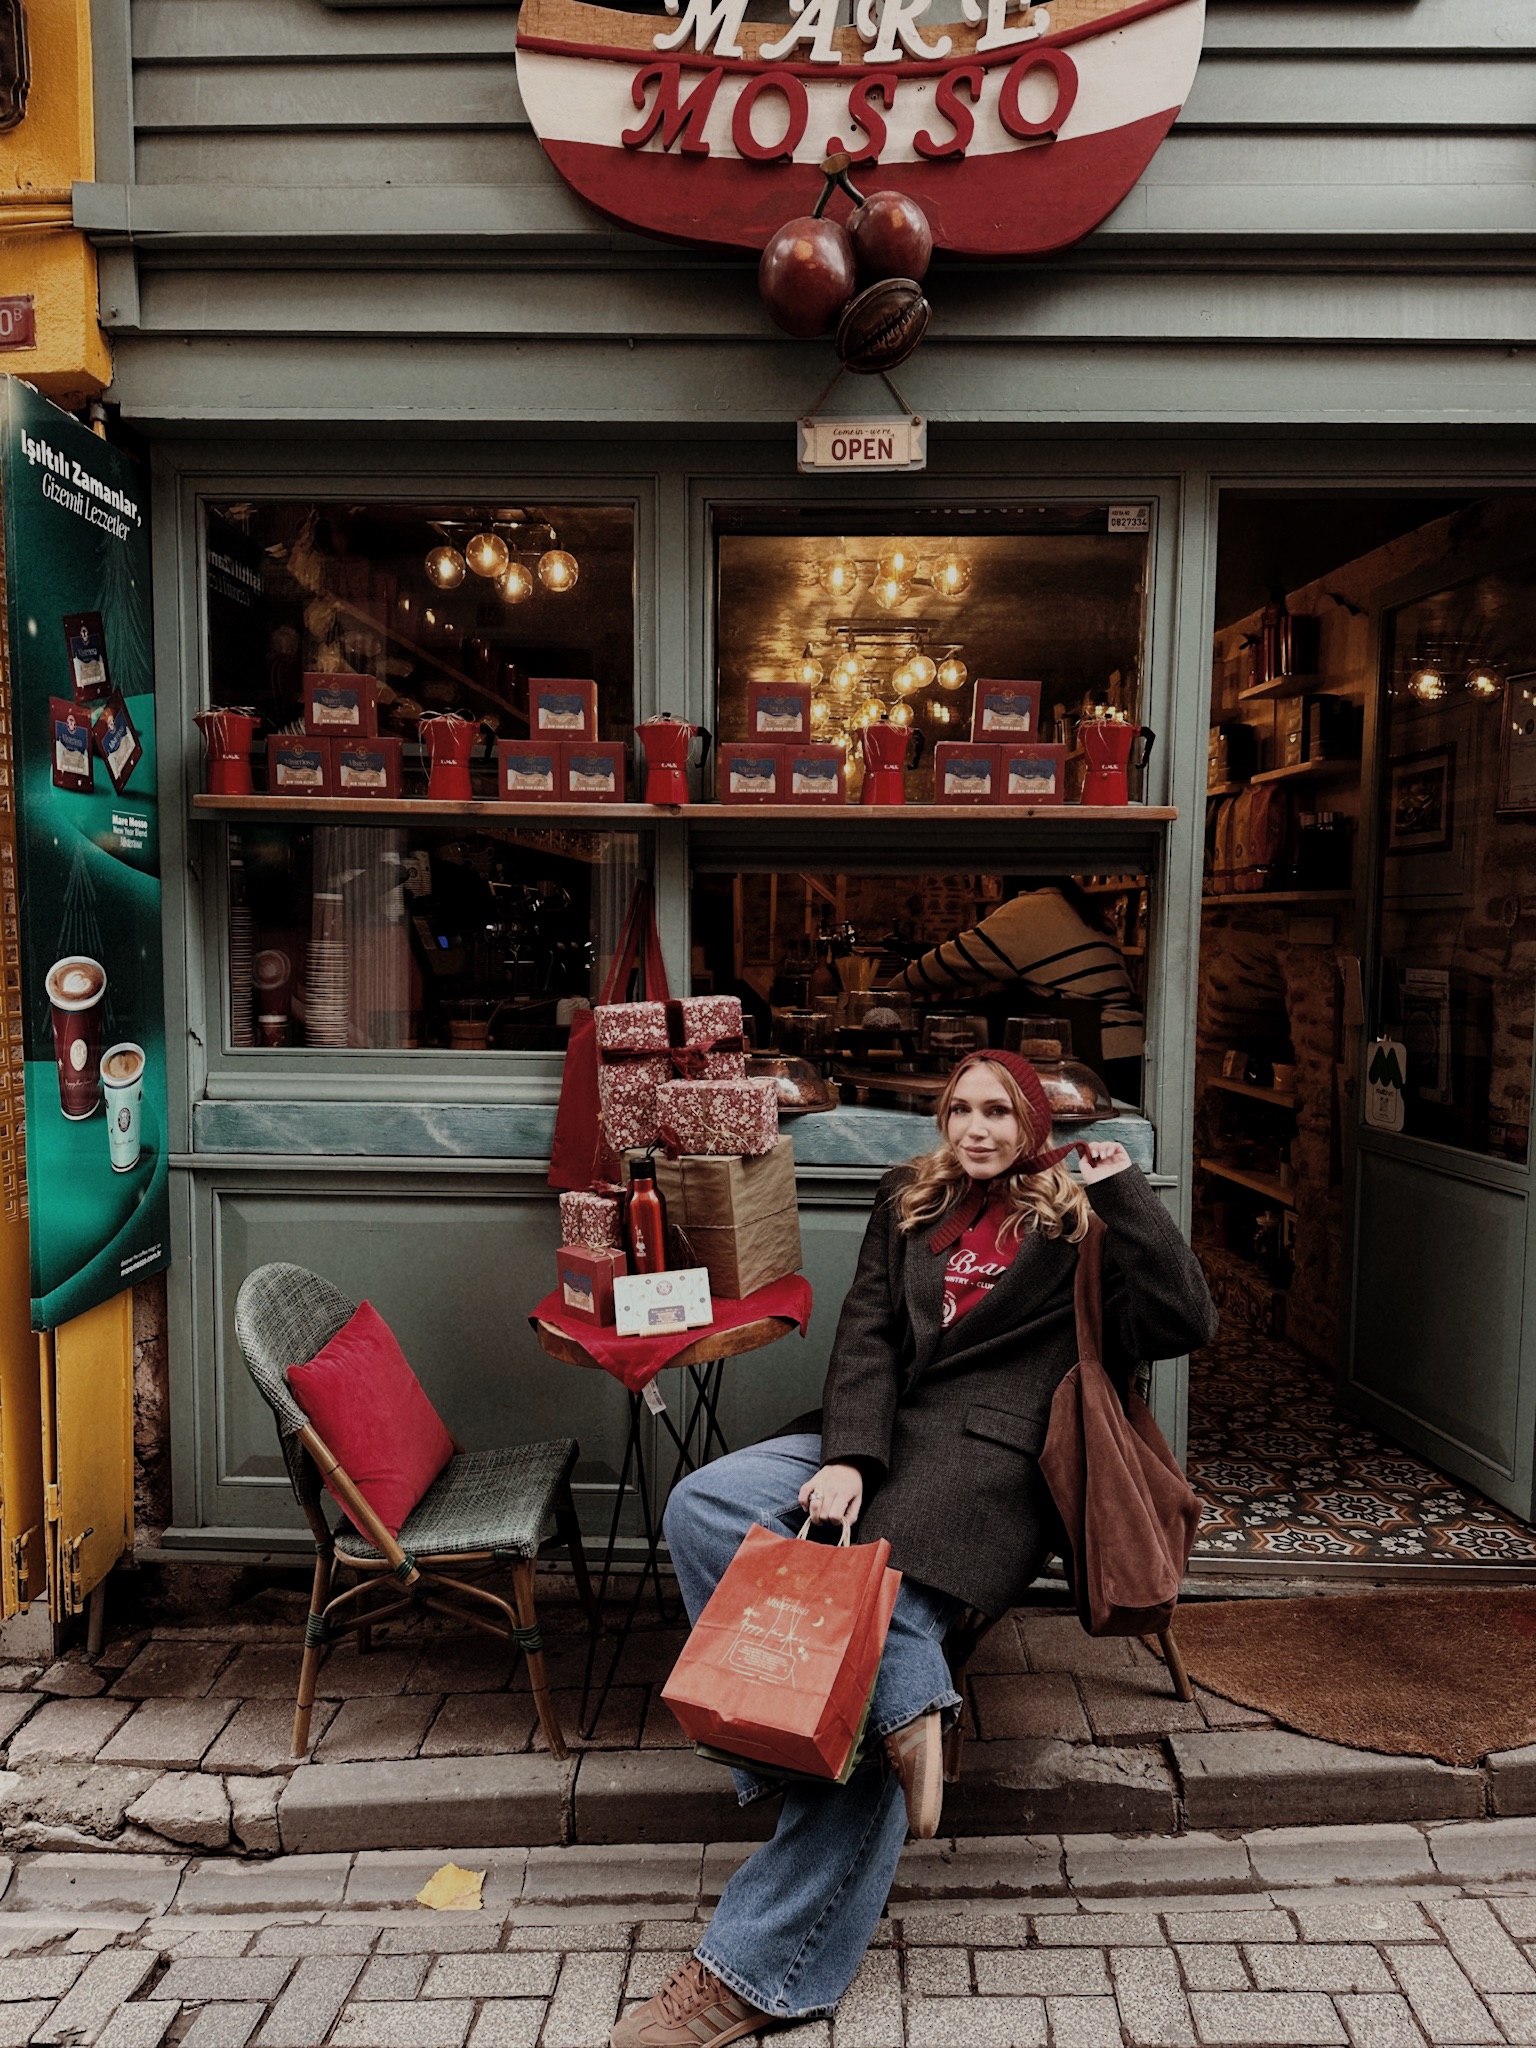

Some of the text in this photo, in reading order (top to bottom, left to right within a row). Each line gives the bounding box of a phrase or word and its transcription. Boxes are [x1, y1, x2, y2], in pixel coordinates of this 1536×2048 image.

[621, 47, 1079, 166] MOSSO
[831, 438, 893, 461] OPEN
[21, 428, 142, 527] Işıltılı Zamanlar,
[42, 472, 131, 542] Gizemli Lezzetler
[1111, 518, 1147, 526] 0827334
[112, 814, 148, 828] Mare Mosso
